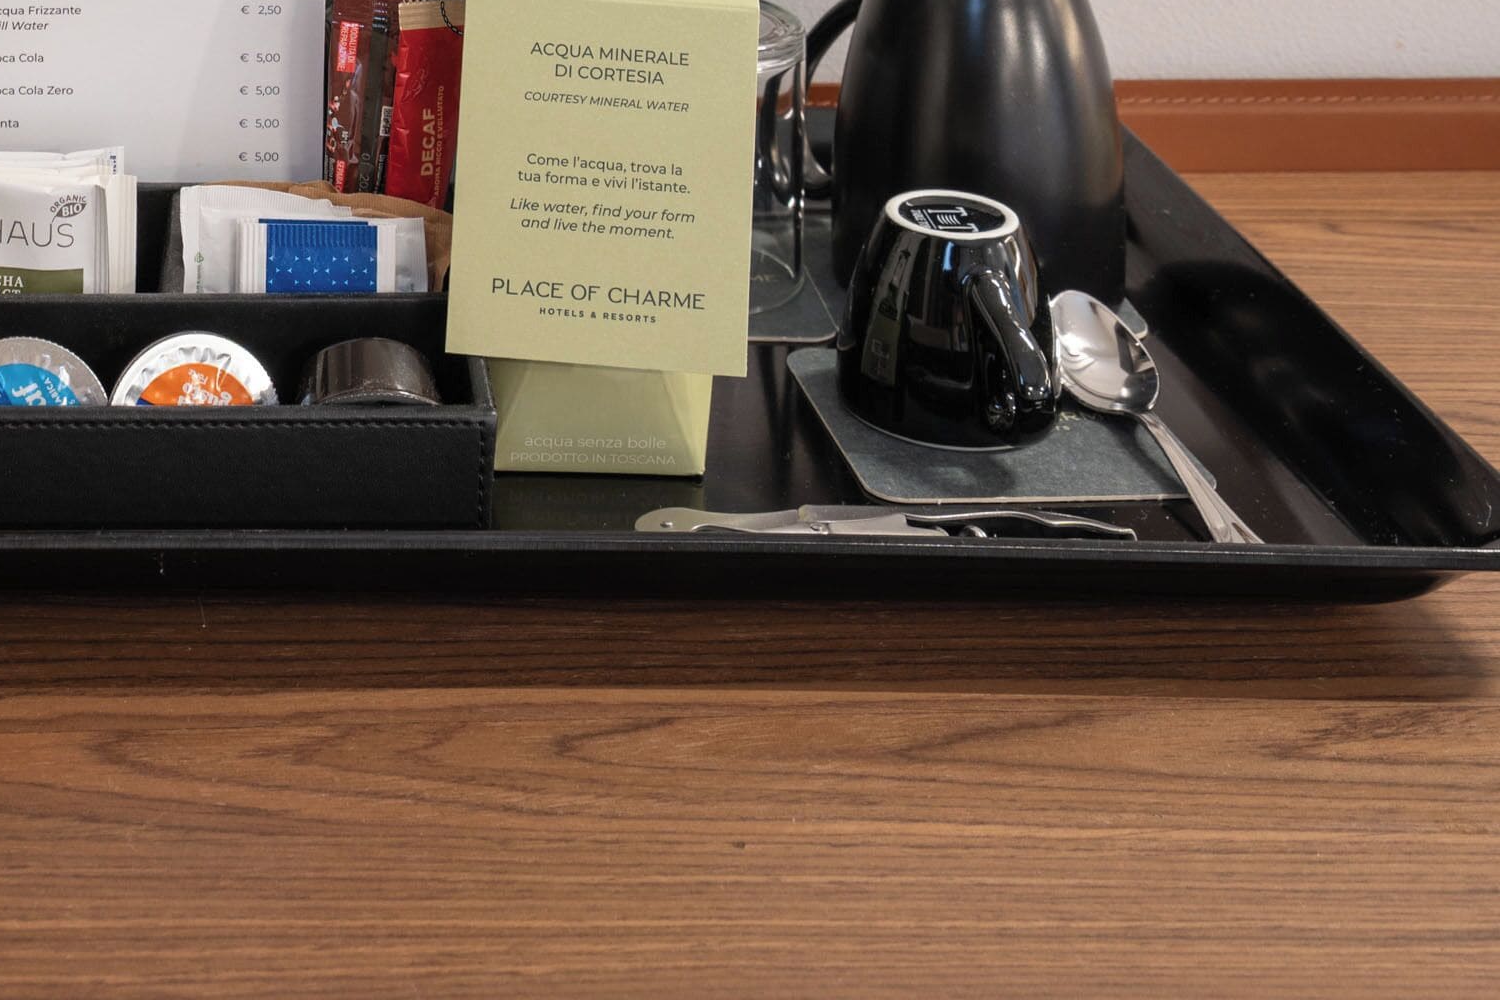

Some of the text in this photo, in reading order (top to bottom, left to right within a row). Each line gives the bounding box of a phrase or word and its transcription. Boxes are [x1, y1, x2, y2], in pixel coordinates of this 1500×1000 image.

[28, 5, 82, 16] Frizzante
[241, 5, 281, 16] € 2,50
[12, 21, 49, 30] Water
[18, 53, 44, 63] Cola
[240, 53, 280, 64] € 5,00
[531, 42, 689, 66] ACQUA MINERALE
[555, 64, 664, 85] DI CORTESIA
[18, 86, 44, 96] Cola
[47, 86, 73, 96] Zero
[239, 86, 280, 97] € 5,00
[524, 91, 689, 112] COURTESY MINERAL WATER
[239, 118, 279, 130] € 5,00
[420, 108, 435, 176] DECAF
[239, 152, 279, 163] € 5,00
[527, 153, 683, 176] Come l'acqua, trova la
[518, 170, 691, 194] tua forma e vivi l'istante.
[50, 194, 86, 212] ORGANIC
[62, 203, 82, 216] BIO
[510, 198, 695, 223] Like water, find your form
[521, 217, 674, 239] and live the moment.
[492, 278, 705, 310] PLACE OF CHARME
[539, 307, 584, 318] HOTELS
[603, 313, 656, 323] RESORTS
[524, 436, 666, 450] acqua senza bolle
[510, 452, 675, 465] PRODOTTO IN TOSCANA
